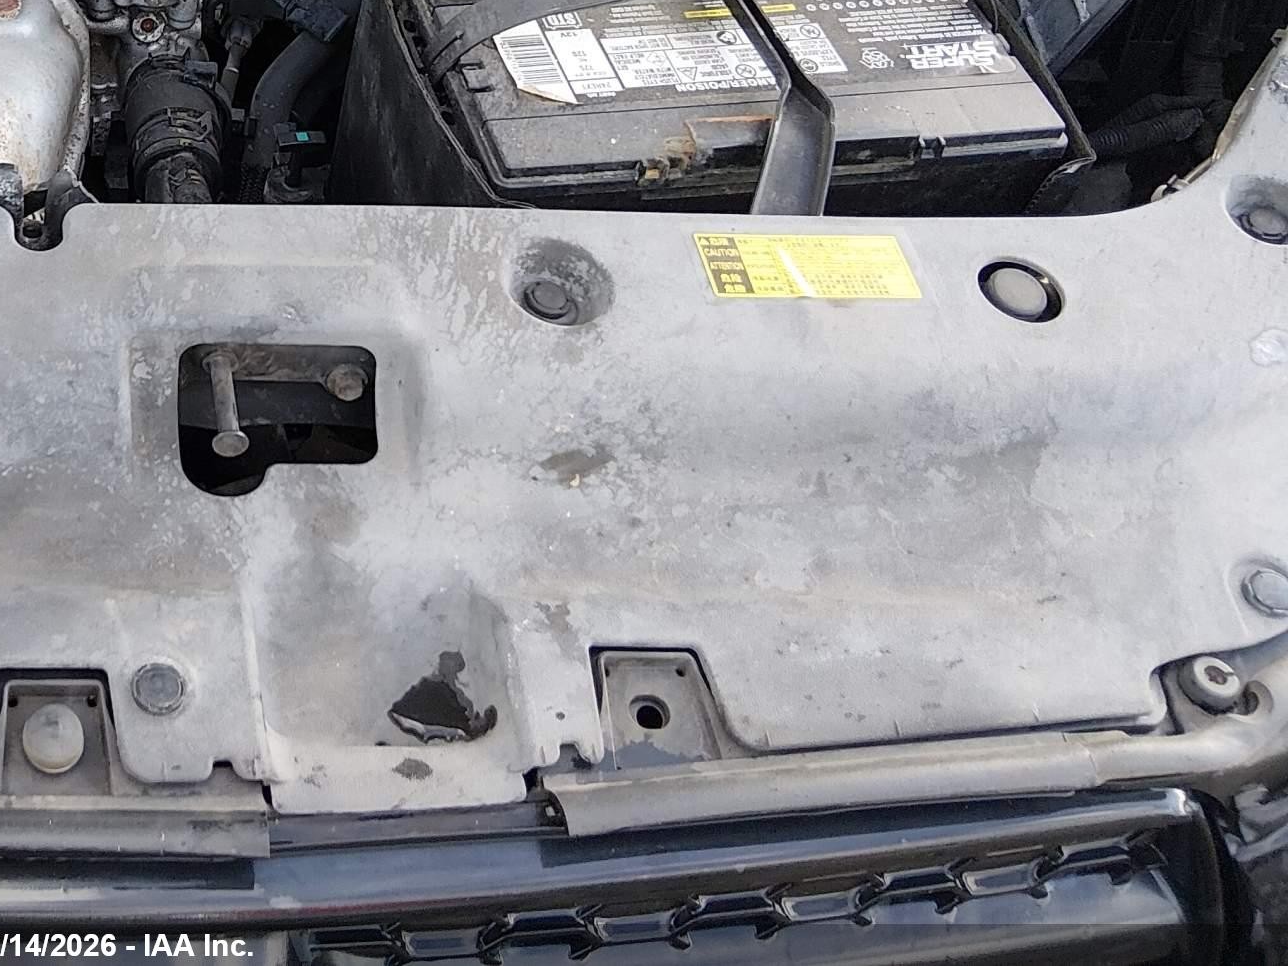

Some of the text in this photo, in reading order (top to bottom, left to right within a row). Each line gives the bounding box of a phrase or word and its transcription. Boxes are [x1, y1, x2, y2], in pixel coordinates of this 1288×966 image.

[907, 40, 996, 57] START
[910, 54, 994, 69] SUPER
[675, 77, 776, 92] ANGER/POISON
[703, 248, 740, 257] CAUTION
